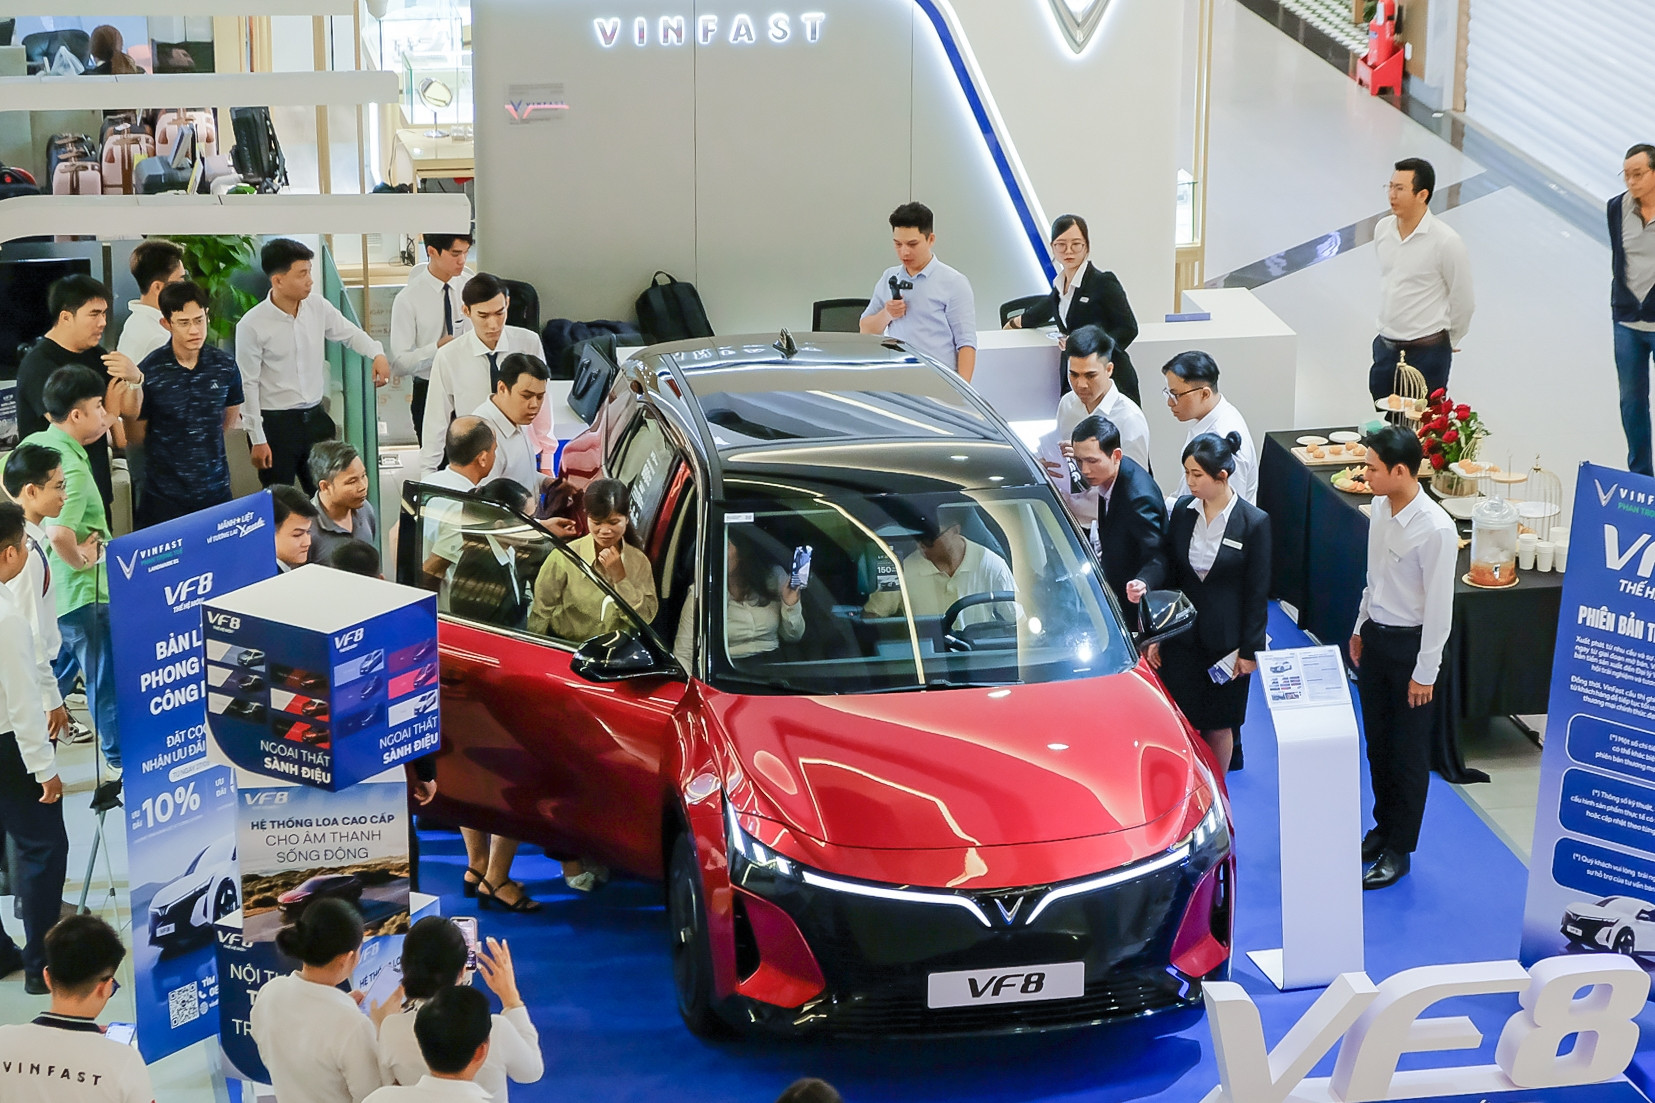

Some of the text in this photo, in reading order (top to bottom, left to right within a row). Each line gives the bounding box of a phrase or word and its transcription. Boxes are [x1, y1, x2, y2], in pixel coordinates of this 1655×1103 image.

[595, 13, 824, 46] VINFAST
[1620, 488, 1655, 505] VINF
[140, 538, 183, 559] VINFAST
[164, 572, 213, 605] VF8
[1619, 579, 1648, 597] THẾ
[207, 611, 241, 629] VF8
[1577, 605, 1616, 632] PHIÊN
[1617, 611, 1645, 639] BẢN
[156, 633, 189, 660] BẢN
[334, 628, 364, 649] VF8
[140, 657, 200, 692] PHONG
[150, 684, 199, 715] CÔNG
[166, 730, 186, 748] ĐẶT
[380, 715, 438, 749] NGOẠI THẤT
[141, 754, 171, 774] NHẬN
[172, 747, 187, 762] ƯU
[188, 740, 206, 756] ĐÃI
[260, 740, 330, 767] NGOẠI THẤT
[383, 732, 438, 765] SÀNH ĐIỆU
[264, 756, 331, 784] SÀNH ĐIỆU
[142, 782, 200, 828] 10%
[245, 791, 289, 805] VF8
[251, 812, 395, 832] HỆ THỐNG LOA CAO CẤP
[265, 830, 381, 847] CHO ÂM THANH
[276, 846, 369, 863] SỐNG ĐỘNG
[230, 963, 260, 985] NỘI
[968, 972, 1045, 998] VF8
[1201, 954, 1651, 1103] VF8
[3, 1061, 102, 1086] VINFAST
